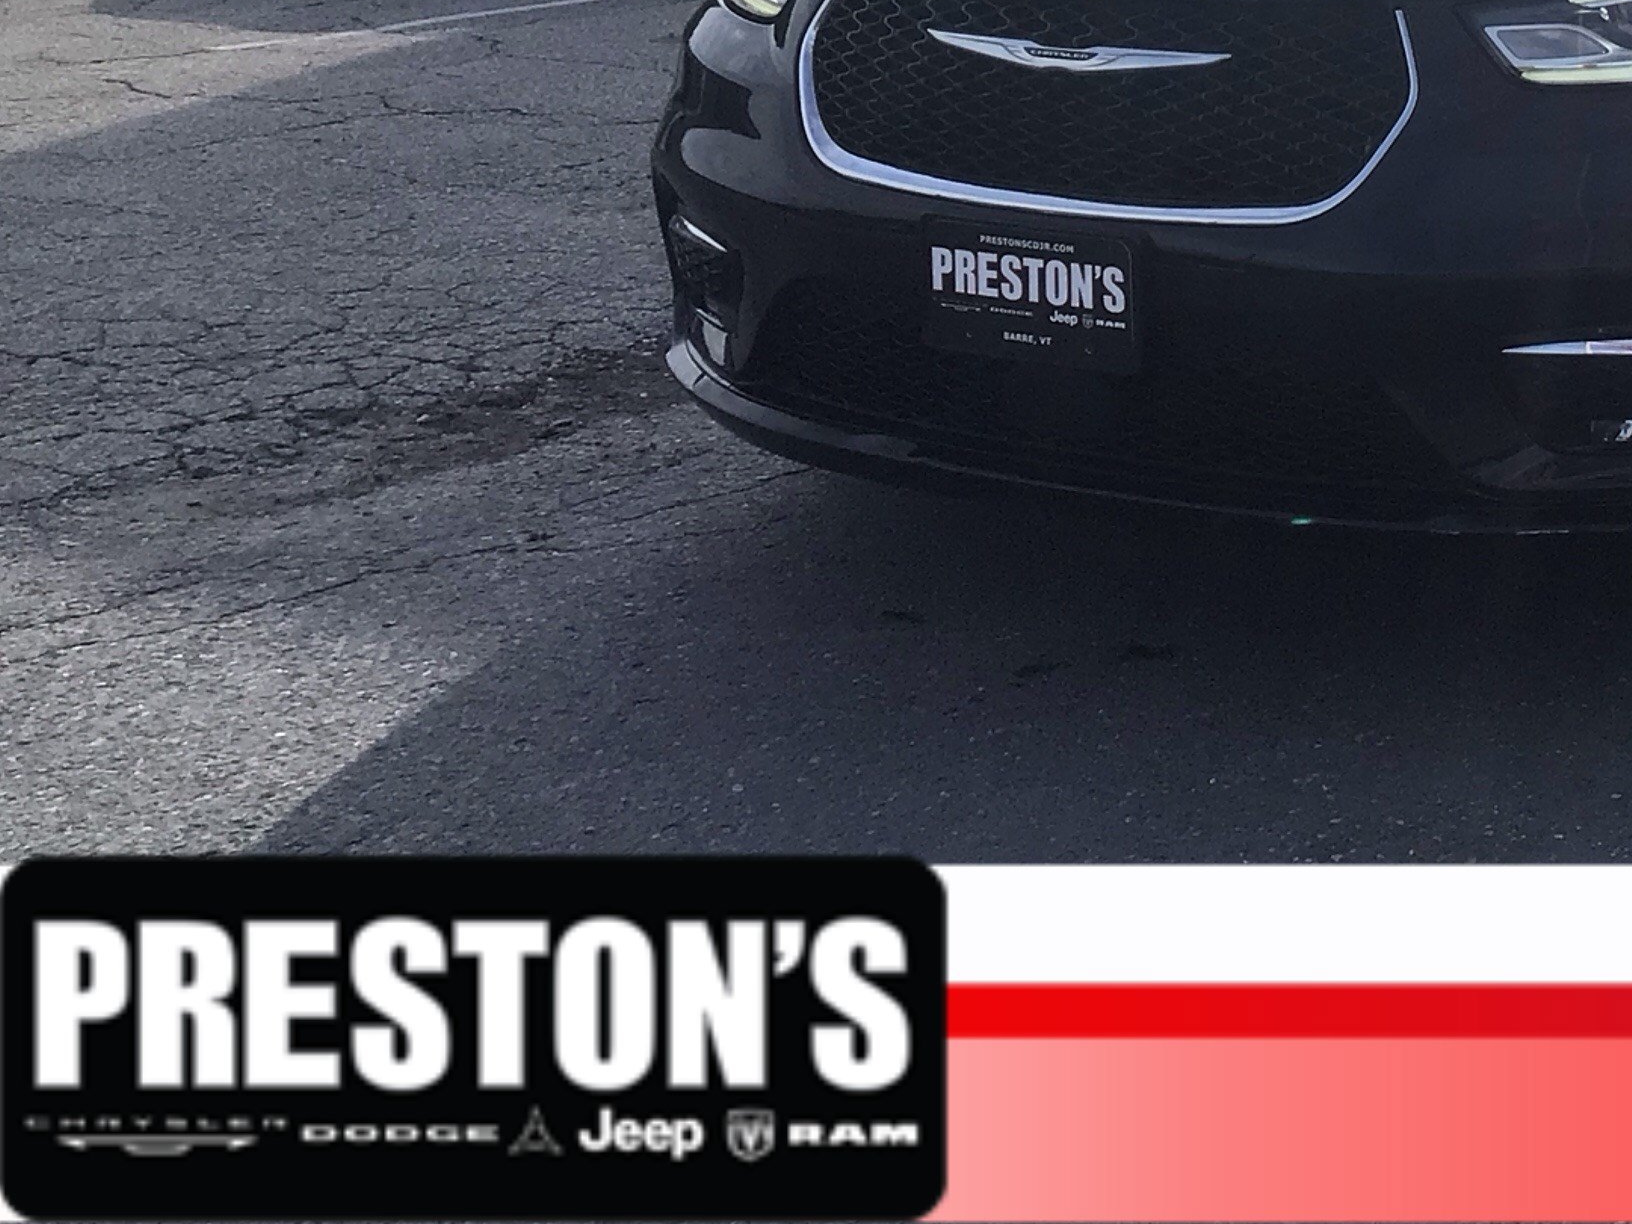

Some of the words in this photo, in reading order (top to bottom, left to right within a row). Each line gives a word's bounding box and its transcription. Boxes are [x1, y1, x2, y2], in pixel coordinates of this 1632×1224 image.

[979, 234, 1075, 254] PRESTONSCDJR.COM
[931, 246, 1126, 314] PRESTON'S
[1049, 310, 1079, 327] Jeep
[1003, 331, 1037, 345] BARRE,
[1039, 336, 1052, 346] VT
